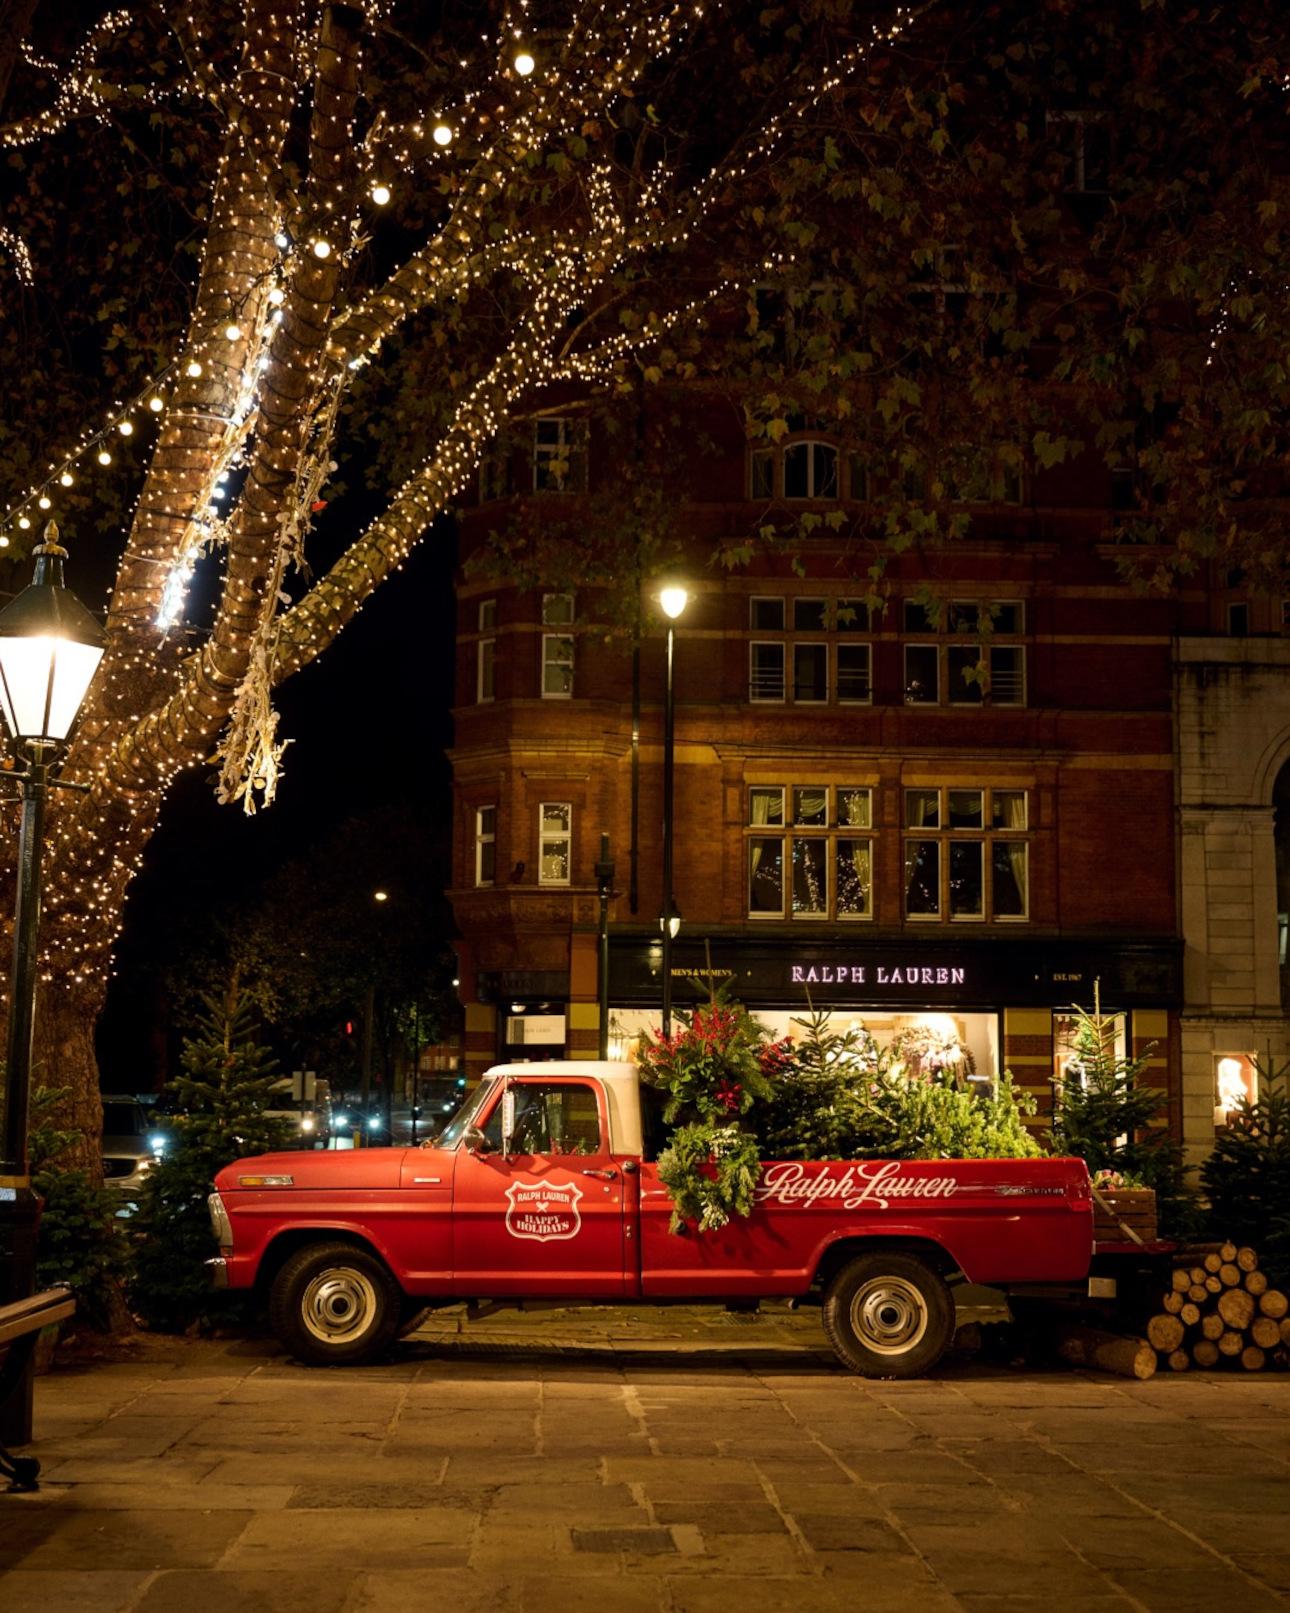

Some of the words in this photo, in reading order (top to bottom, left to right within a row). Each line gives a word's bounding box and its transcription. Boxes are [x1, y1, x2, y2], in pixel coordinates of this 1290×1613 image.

[792, 966, 865, 983] RALPH
[877, 967, 965, 984] LAUREN
[755, 1163, 856, 1208] Ralph
[843, 1161, 957, 1209] Lauren
[517, 1191, 541, 1202] RALPH
[542, 1191, 569, 1203] LAUREN
[525, 1214, 560, 1225] HAPPY
[517, 1220, 569, 1233] HOLIDAYS
